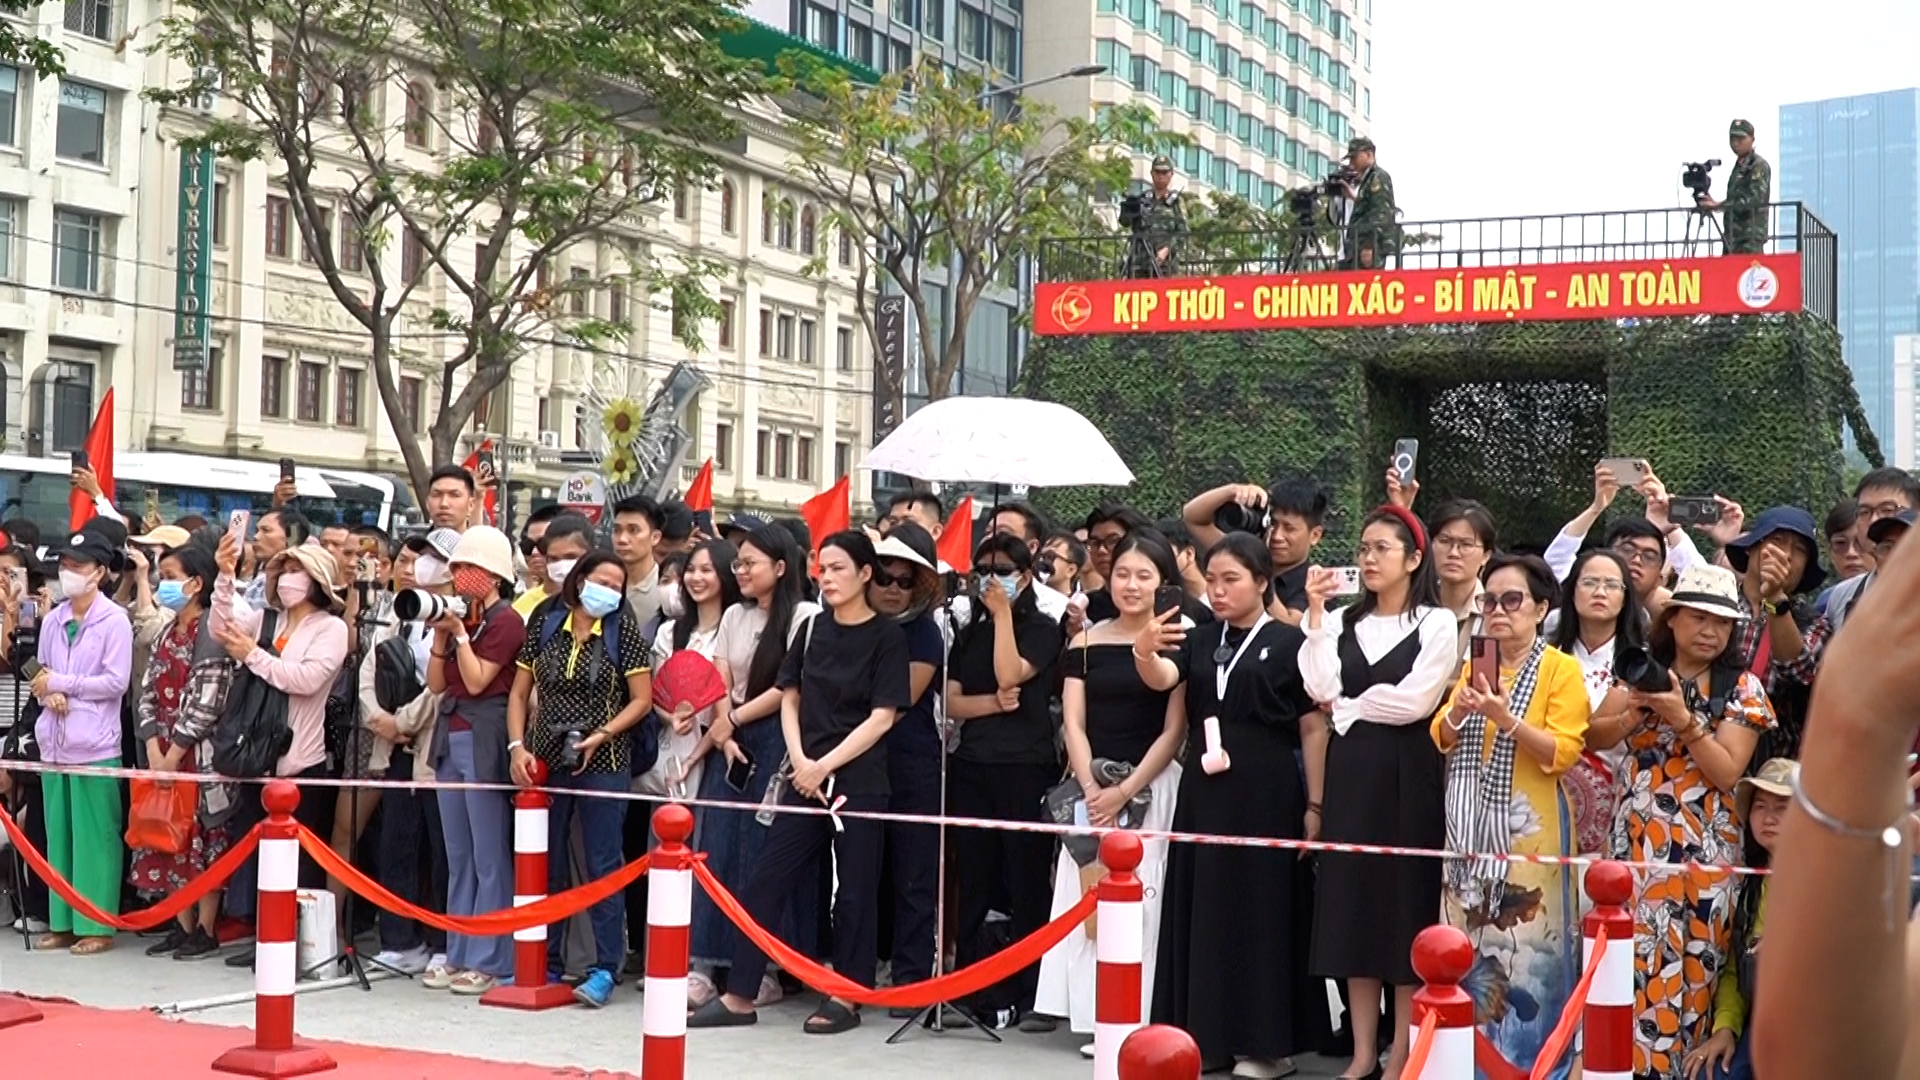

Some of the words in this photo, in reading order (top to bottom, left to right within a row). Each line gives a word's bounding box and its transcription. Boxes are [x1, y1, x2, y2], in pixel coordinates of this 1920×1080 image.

[1113, 291, 1158, 330] KỊP
[1165, 280, 1225, 322] THỜI
[1253, 278, 1339, 319] CHÍNH
[1347, 275, 1405, 316] XÁC
[1434, 272, 1464, 312] BÍ
[1473, 269, 1537, 318] MẬT
[1566, 273, 1610, 308] AN
[1619, 263, 1701, 307] TOÀN
